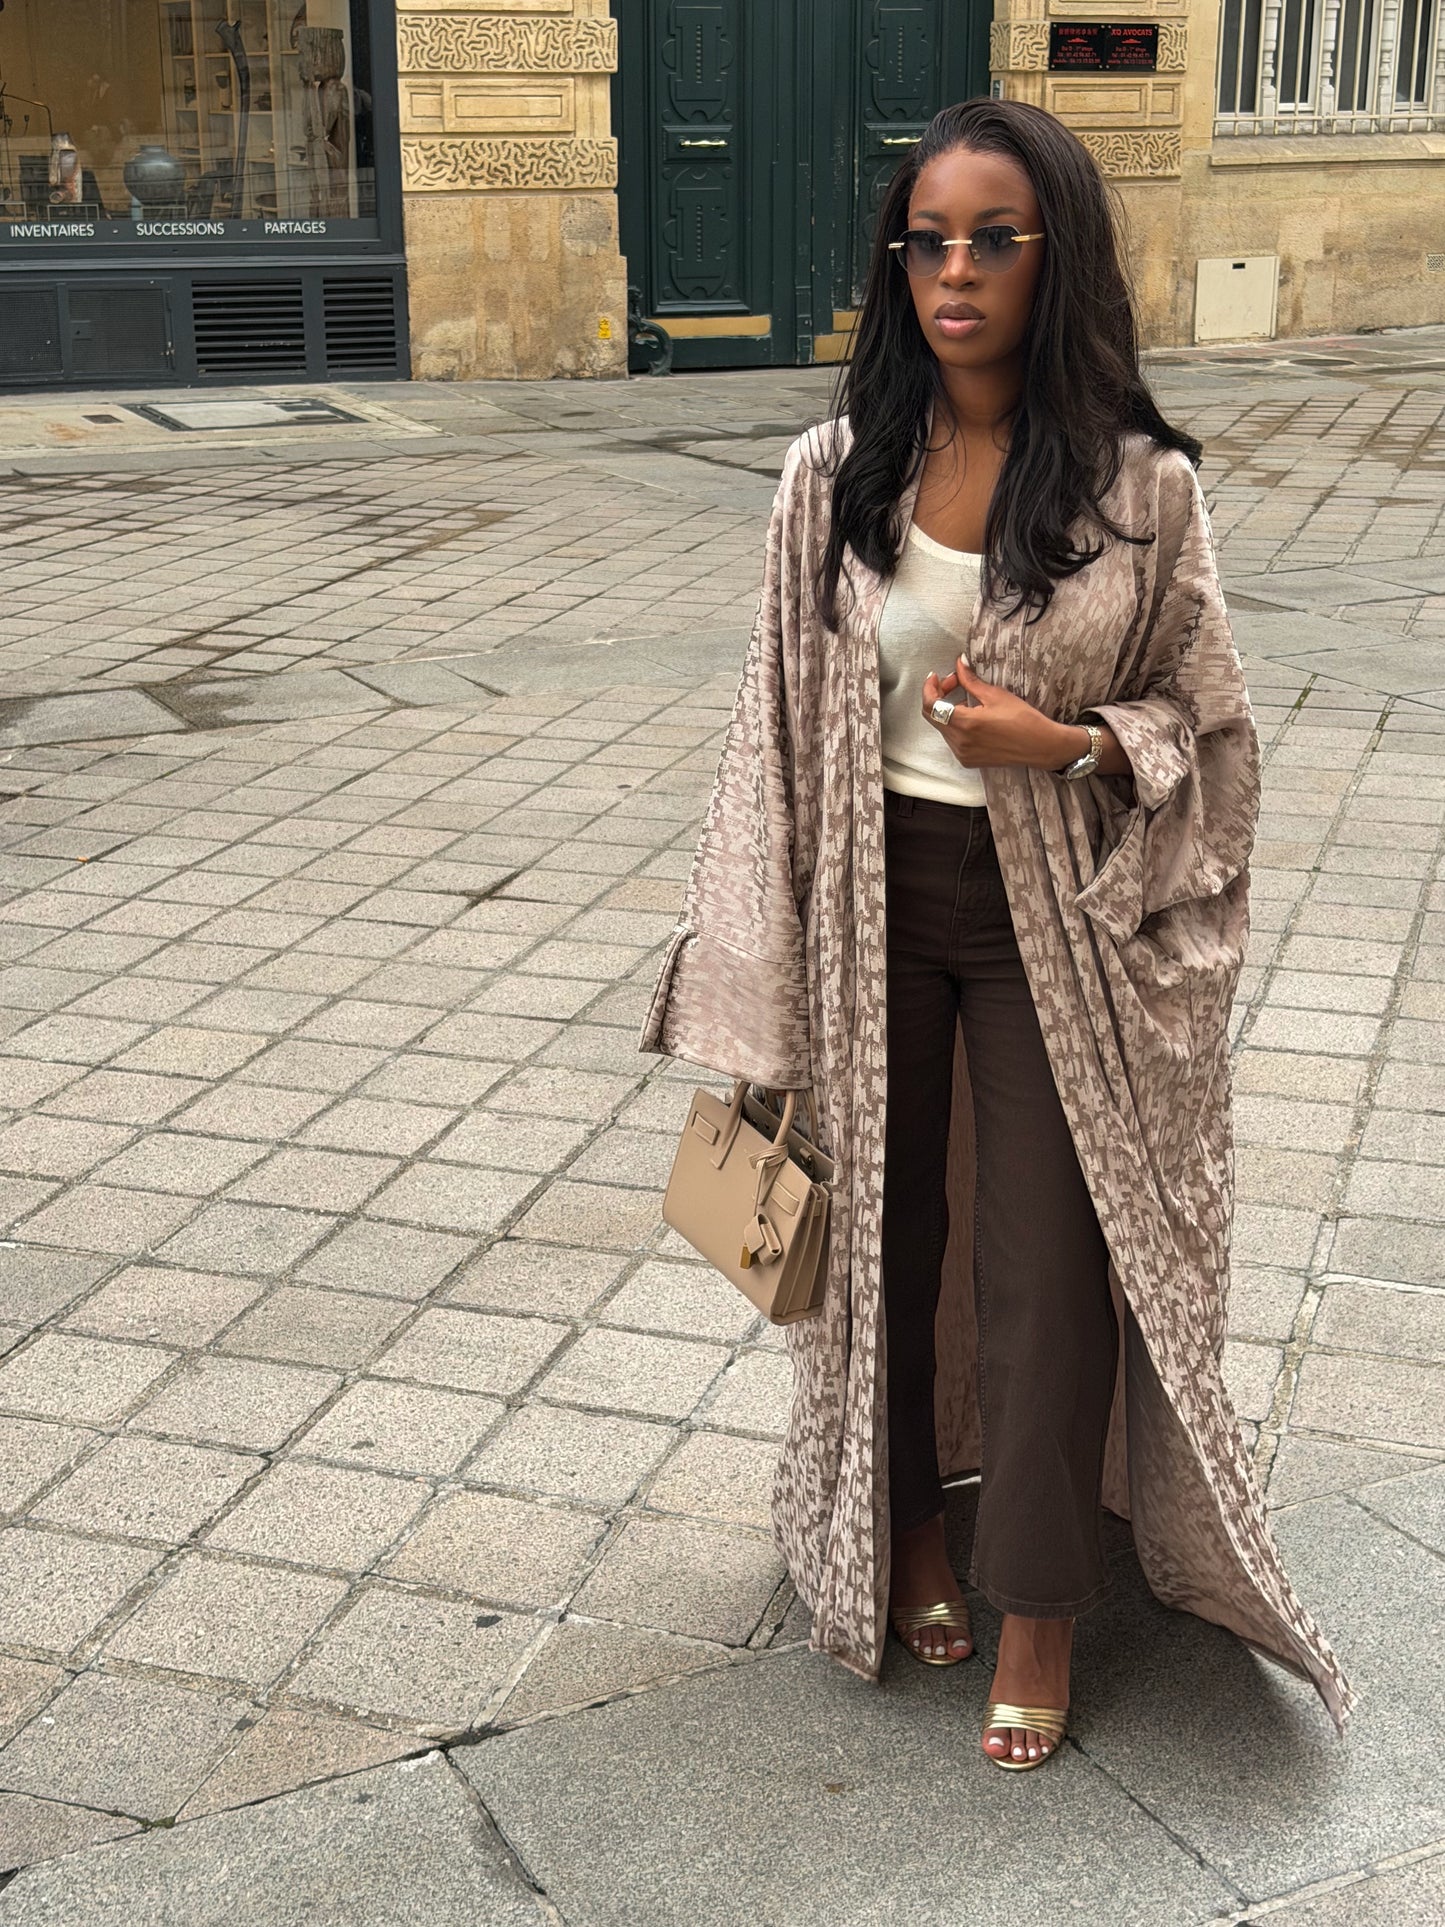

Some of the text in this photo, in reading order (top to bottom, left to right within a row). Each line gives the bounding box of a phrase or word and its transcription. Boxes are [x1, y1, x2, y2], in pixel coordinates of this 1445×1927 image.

[10, 224, 95, 237] INVENTAIRES
[136, 222, 225, 236] SUCCESSIONS
[264, 221, 327, 234] PARTAGES
